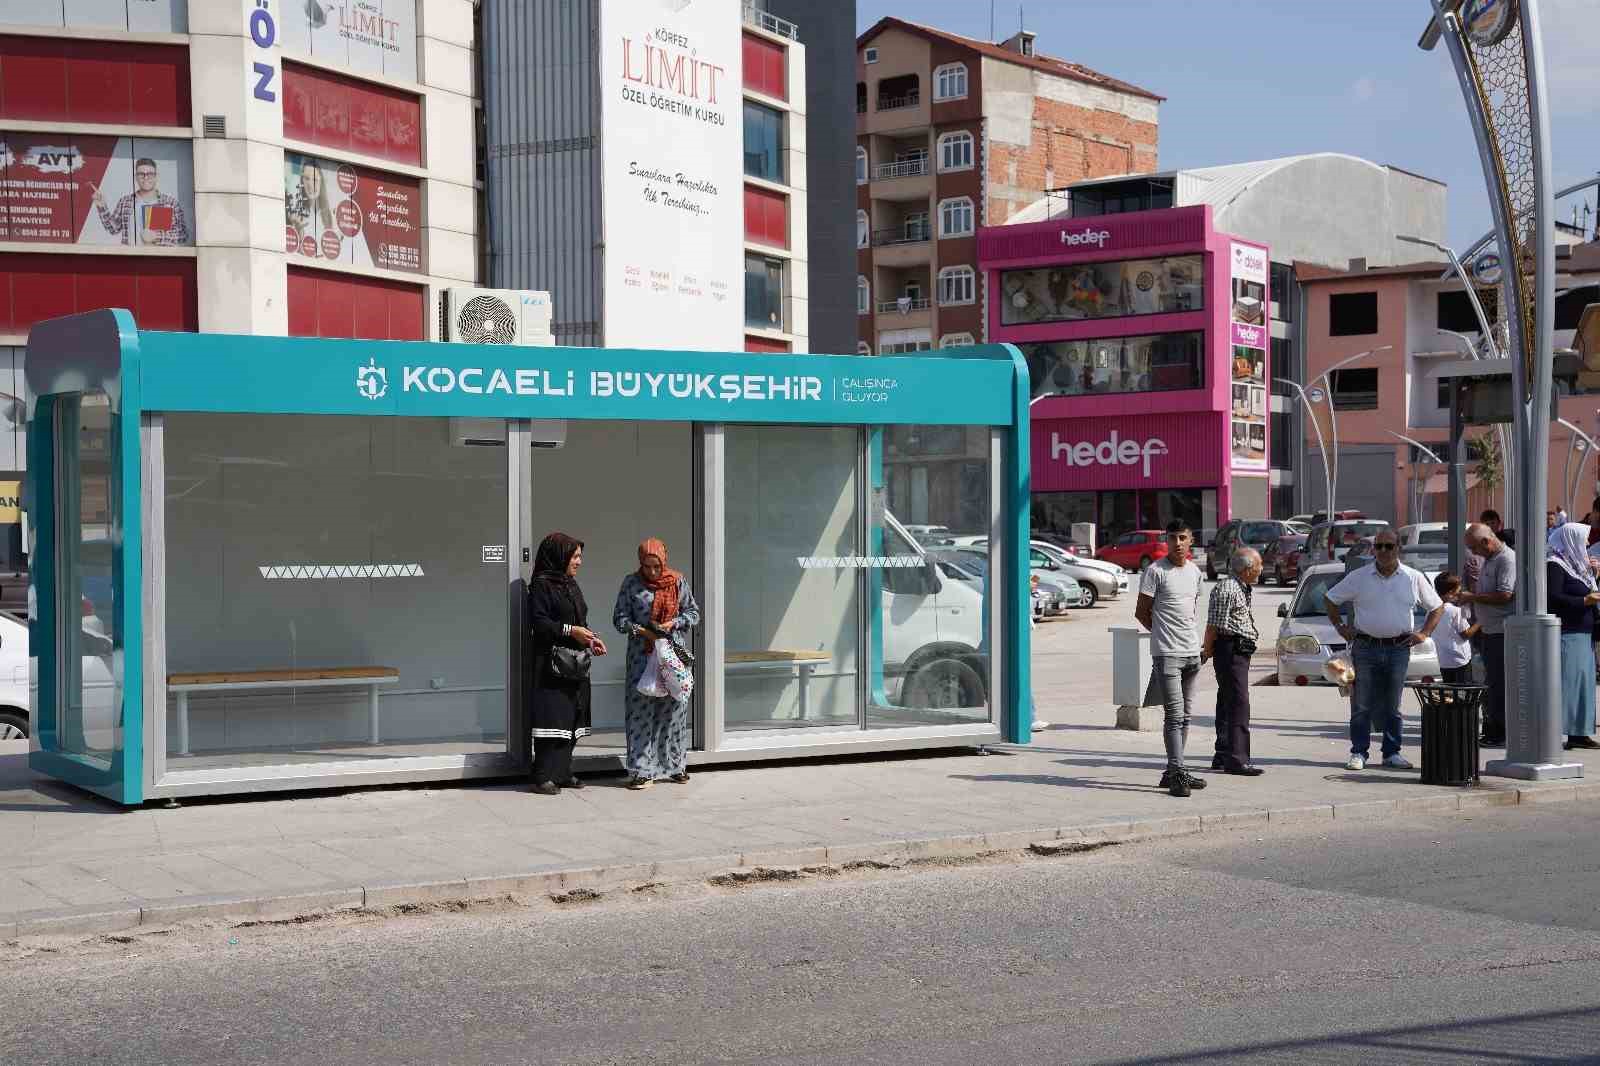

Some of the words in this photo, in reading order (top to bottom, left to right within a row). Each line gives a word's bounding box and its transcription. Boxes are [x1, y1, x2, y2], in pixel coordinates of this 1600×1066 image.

[655, 28, 688, 48] KÖRFEZ
[622, 32, 724, 104] LİMİT
[622, 84, 647, 105] ÖZEL
[649, 91, 692, 117] ÖĞRETİM
[695, 107, 725, 126] KURSU
[38, 152, 76, 166] AYT
[1060, 228, 1111, 248] hedef
[1051, 430, 1169, 478] hedef
